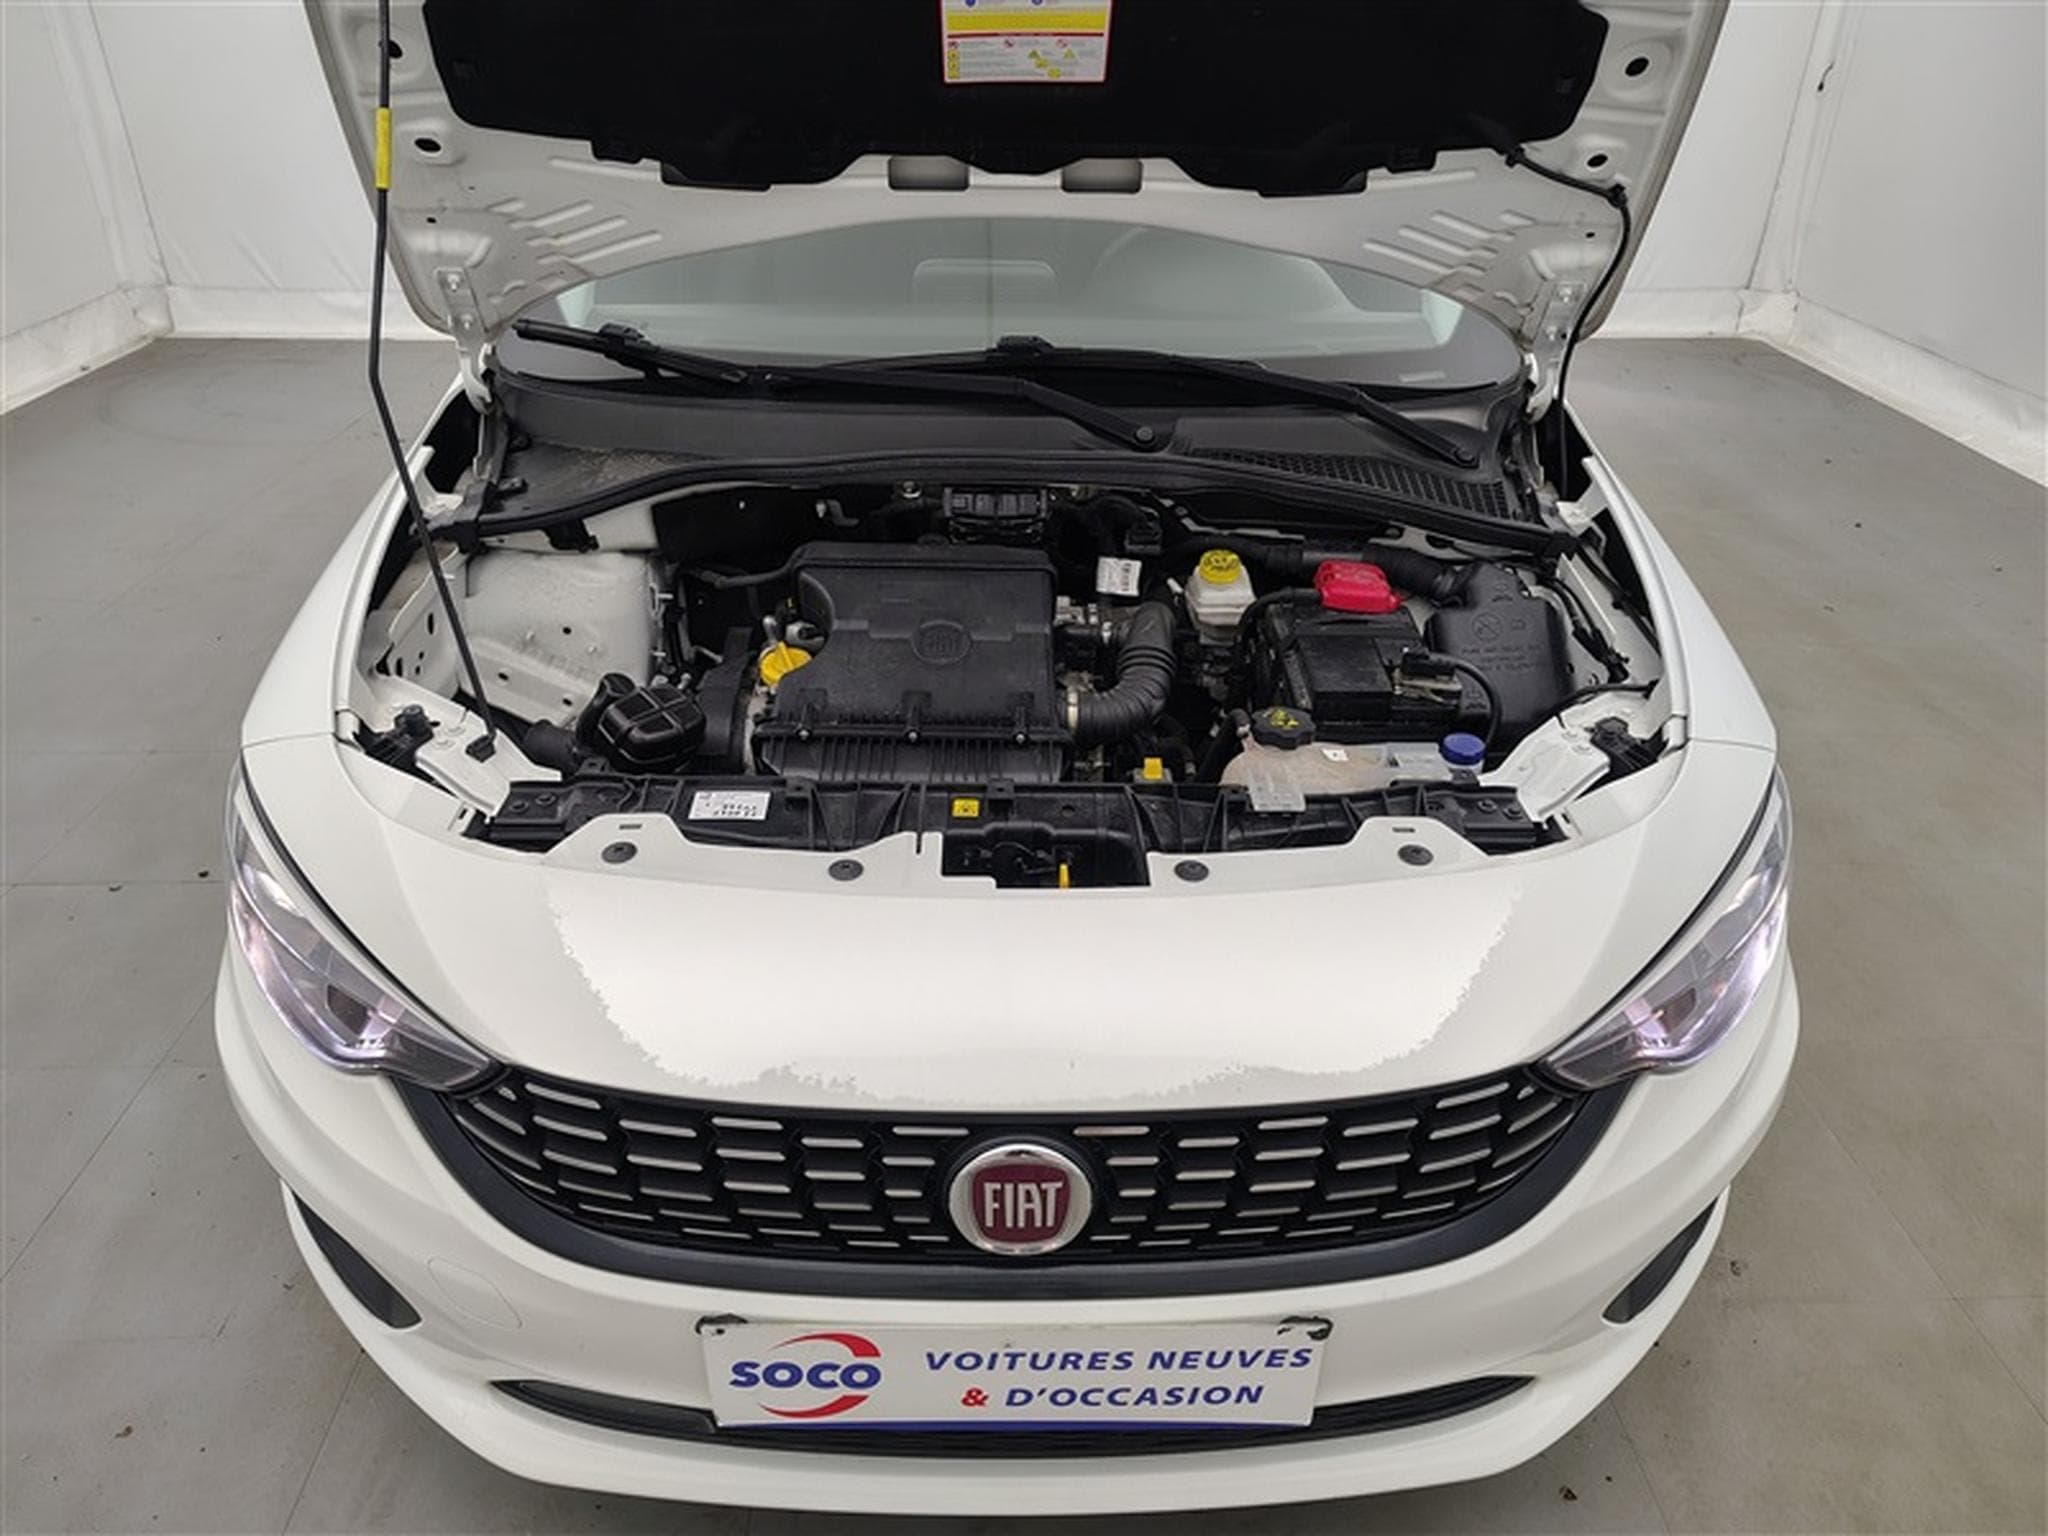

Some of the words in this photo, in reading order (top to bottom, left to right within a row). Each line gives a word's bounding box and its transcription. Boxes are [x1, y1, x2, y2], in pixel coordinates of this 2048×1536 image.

[983, 1181, 1063, 1229] FIAT
[925, 1350, 1134, 1372] VOITURES
[1147, 1348, 1313, 1370] NEUVES
[729, 1360, 882, 1390] SOCO
[961, 1387, 990, 1407] &
[1005, 1385, 1264, 1407] D'OCCASION
